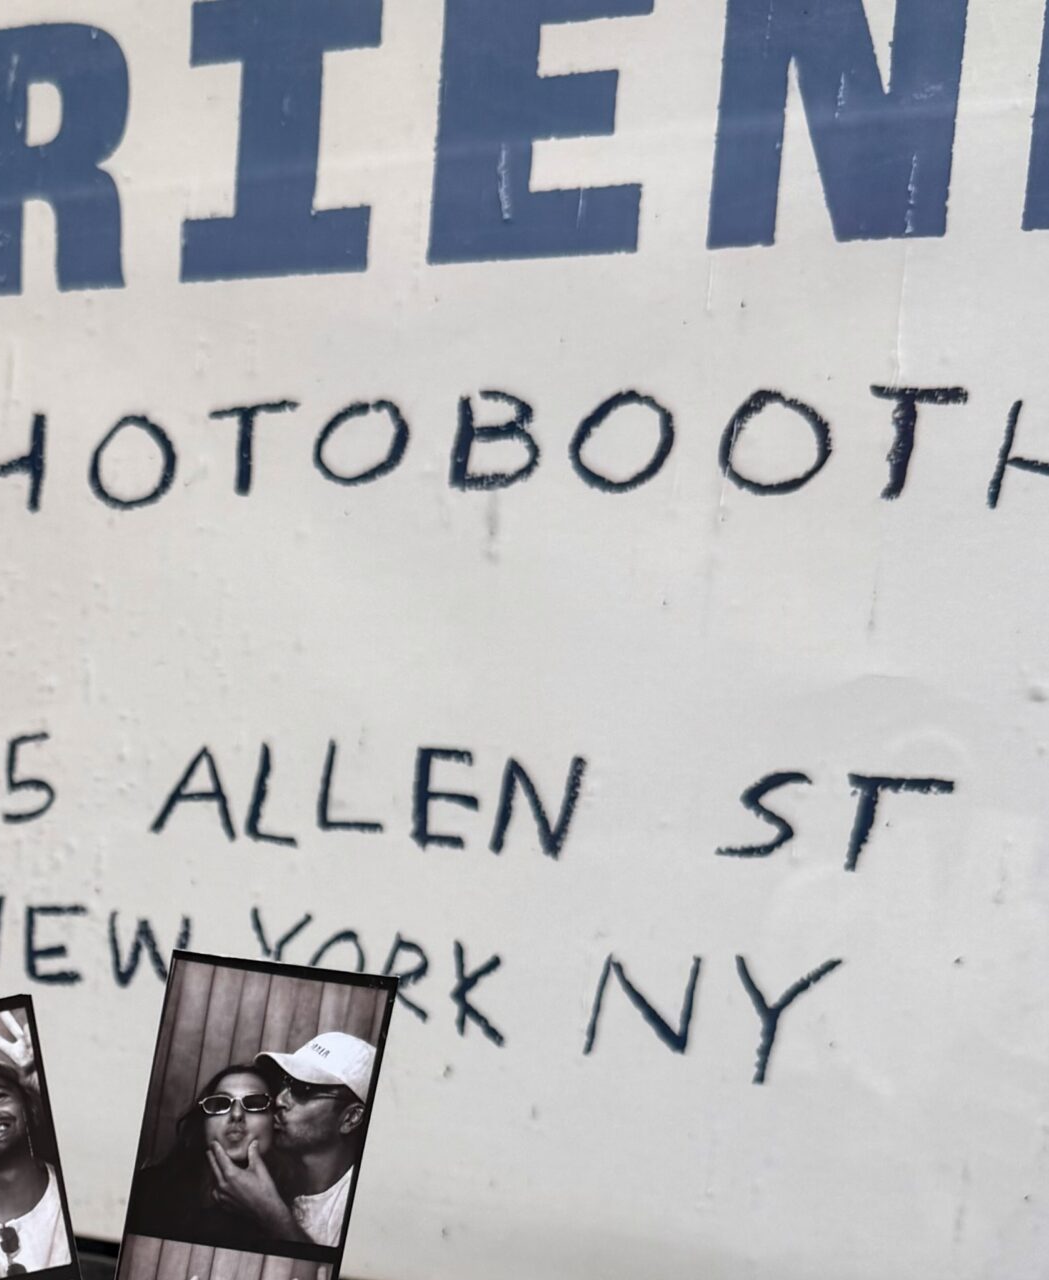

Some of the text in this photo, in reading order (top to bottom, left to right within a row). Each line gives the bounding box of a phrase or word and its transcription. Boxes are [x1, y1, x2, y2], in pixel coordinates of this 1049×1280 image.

[150, 739, 588, 861] ALLEN
[715, 770, 956, 872] ST
[583, 954, 843, 1085] NY
